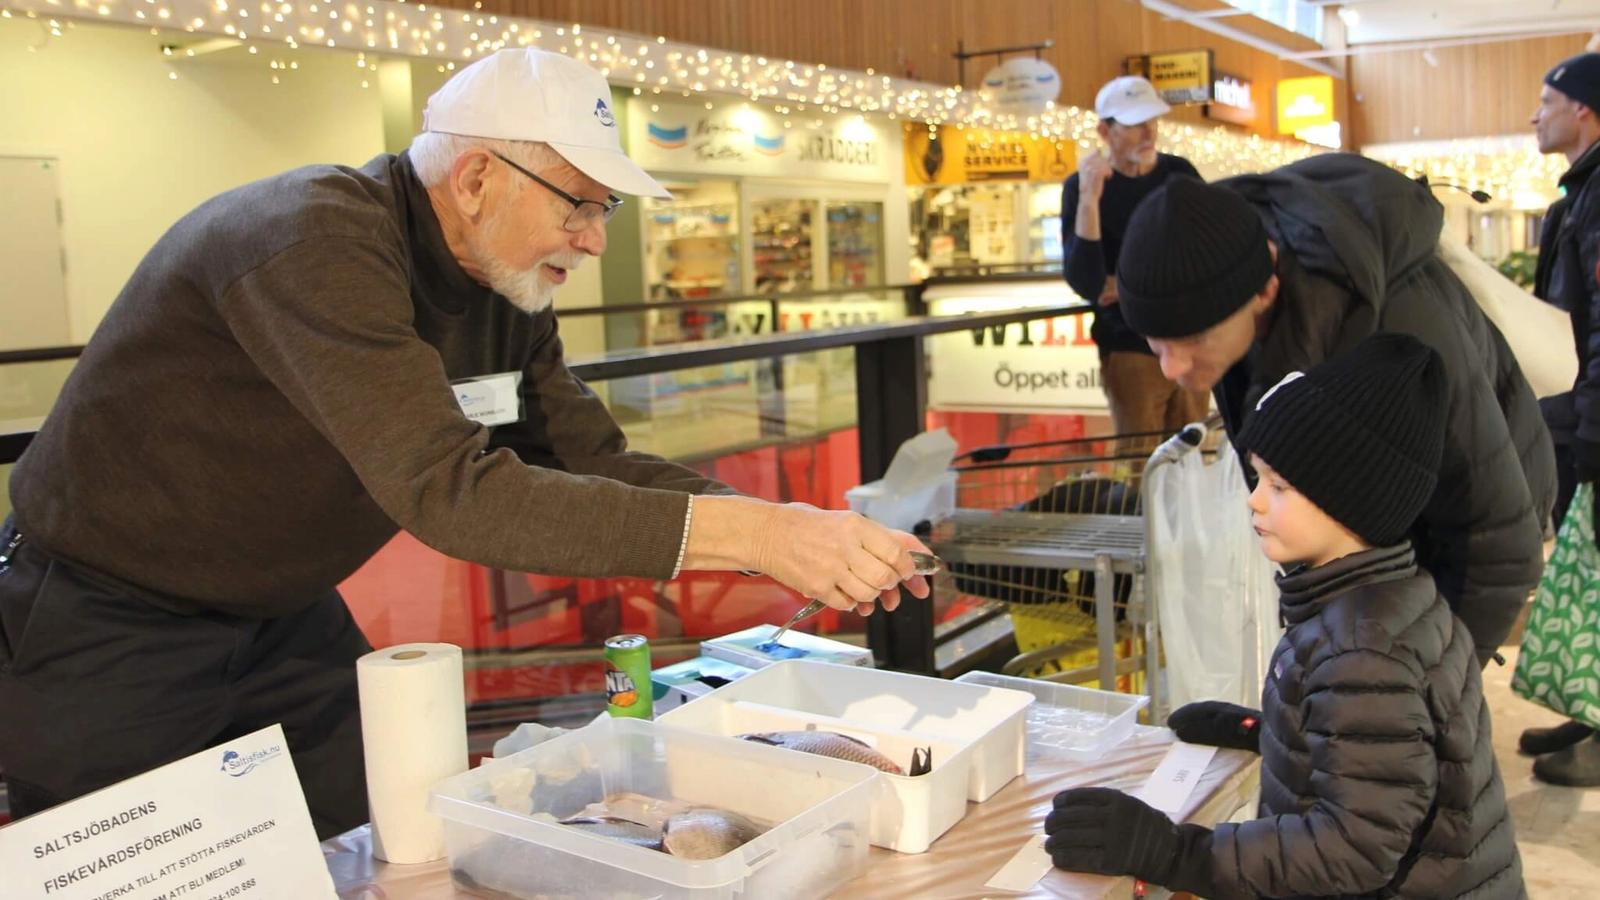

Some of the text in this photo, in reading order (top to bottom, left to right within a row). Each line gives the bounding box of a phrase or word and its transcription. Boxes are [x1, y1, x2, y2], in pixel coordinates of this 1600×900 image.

[964, 155, 1029, 167] SERVICE
[994, 361, 1070, 393] Öppet
[33, 800, 158, 859] SALTSJÖBADENS
[44, 817, 203, 894] FISKEVÅRDSFÖRENING
[91, 819, 276, 900] VERKA TILL ATT STÖTTA FISKEVÅRDEN
[169, 881, 187, 899] ATT
[189, 876, 205, 891] BLI
[205, 857, 246, 883] MEDLEM!
